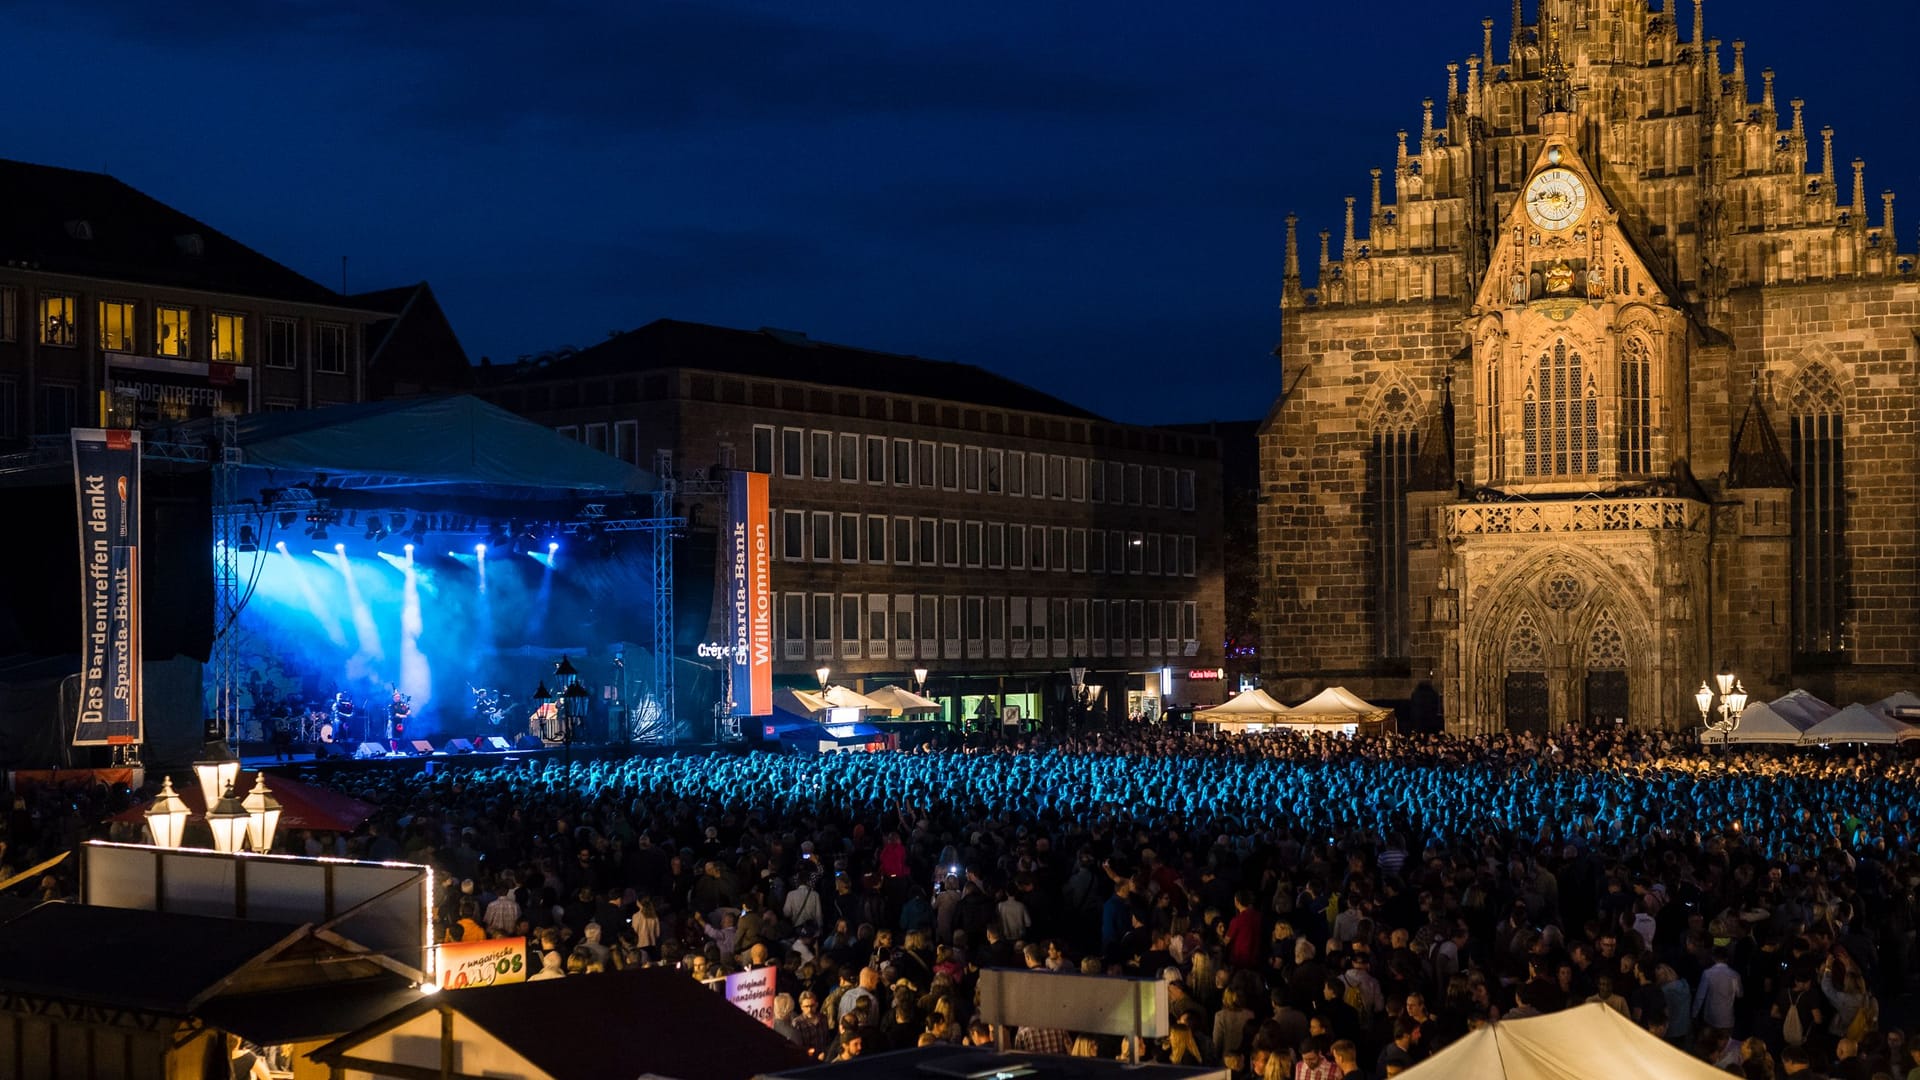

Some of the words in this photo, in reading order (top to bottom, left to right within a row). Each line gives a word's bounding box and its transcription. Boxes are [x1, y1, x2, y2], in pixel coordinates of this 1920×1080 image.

[87, 474, 108, 533] dankt
[87, 545, 109, 681] Bardentreffen
[735, 522, 747, 666] Sparda-Bank
[755, 524, 768, 666] Willkommen
[114, 567, 129, 701] Sparda-Bank
[82, 688, 103, 724] Das
[1803, 737, 1833, 745] Tucher
[467, 947, 513, 968] ungarische
[732, 988, 774, 1002] ranzösische
[737, 977, 767, 991] original
